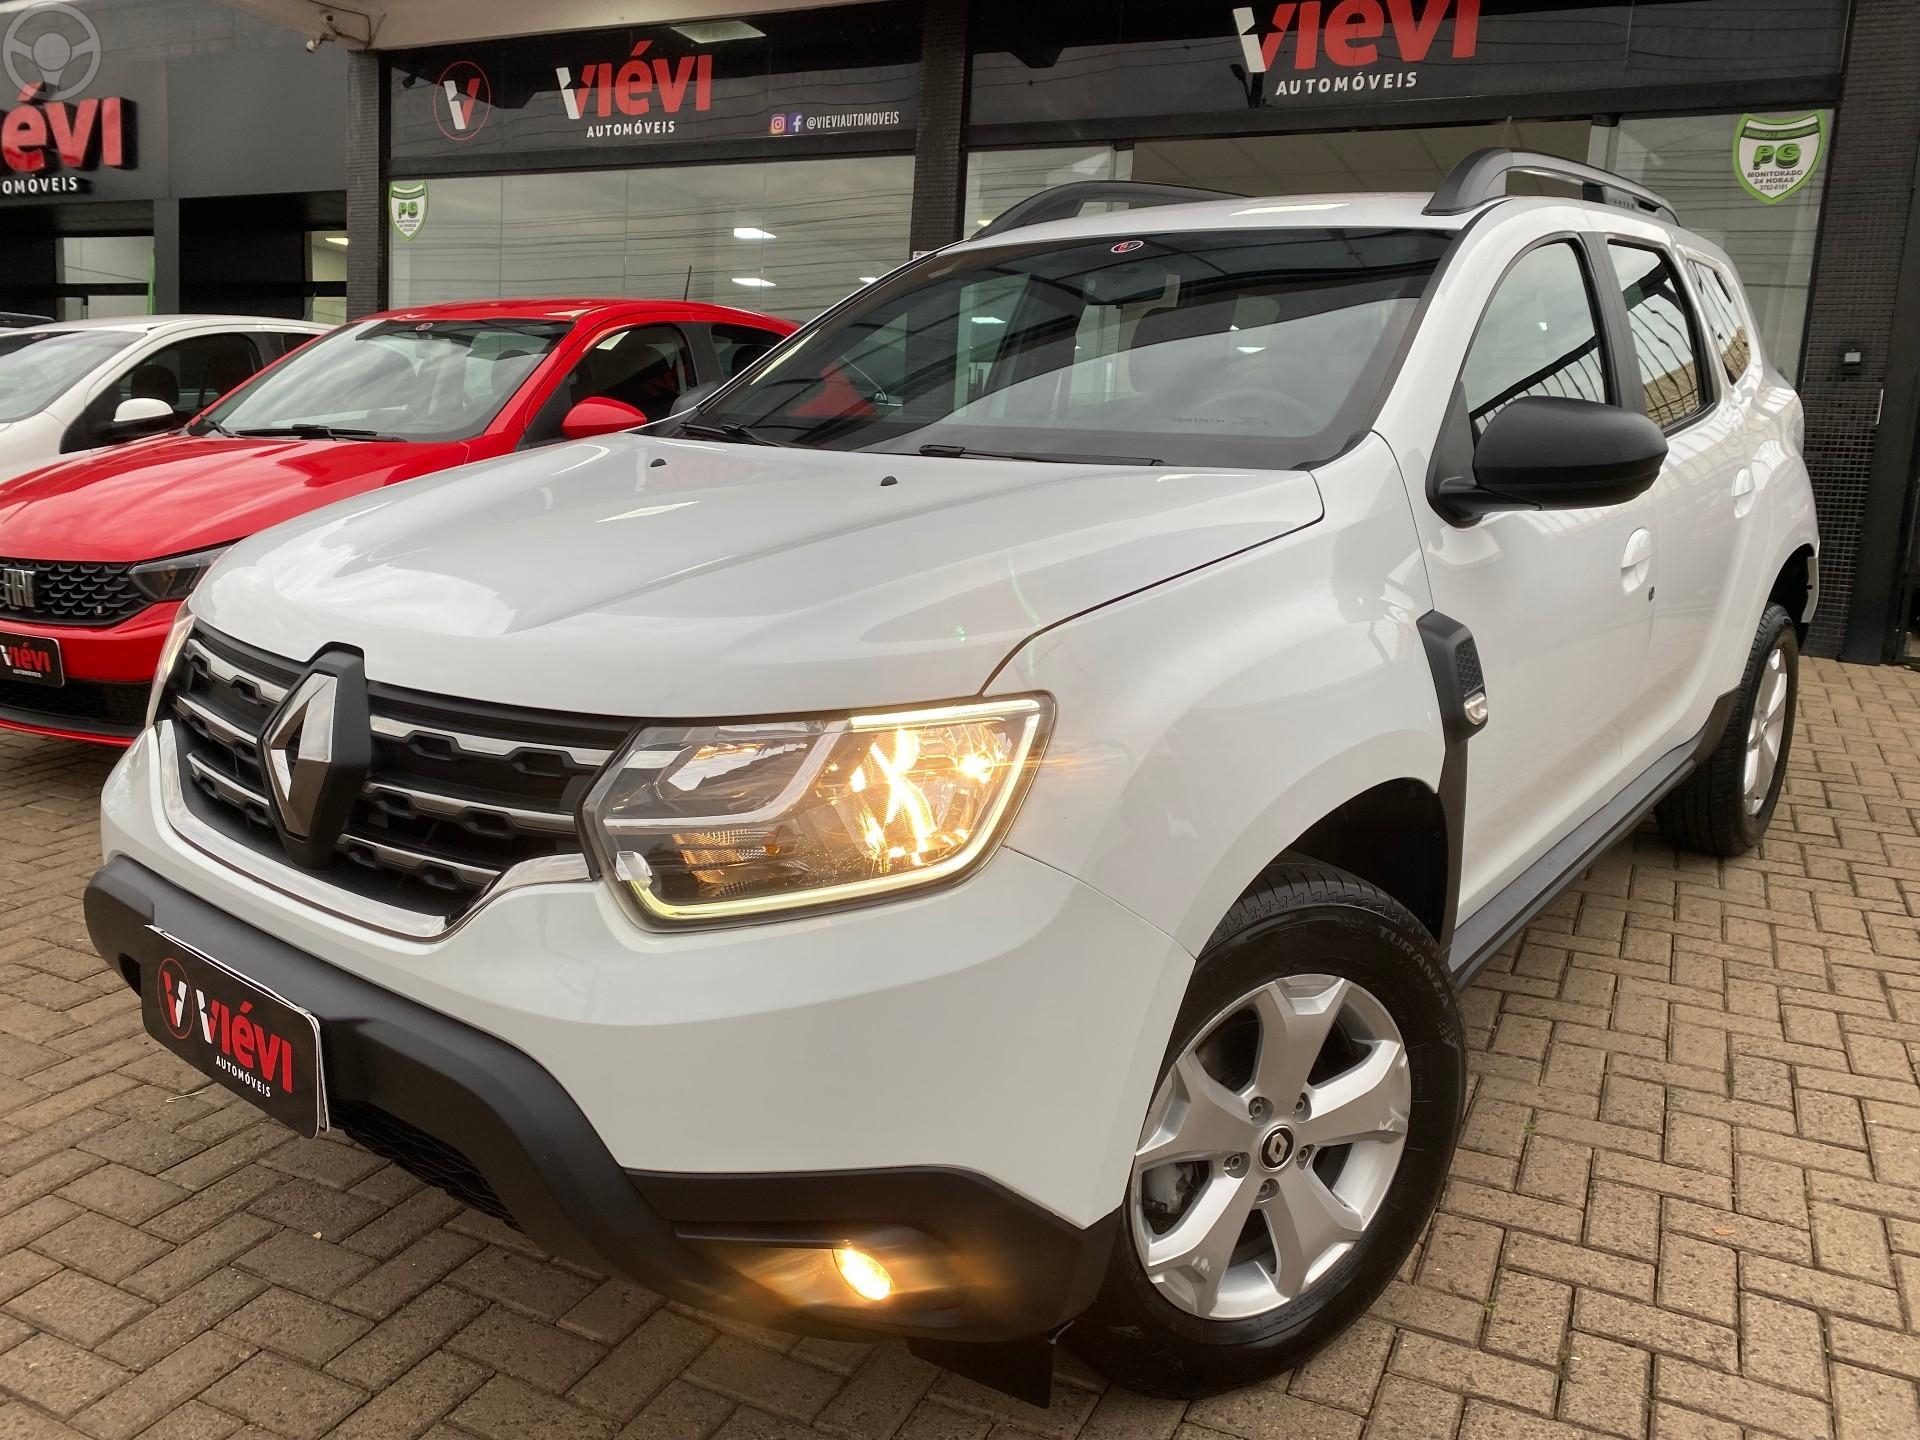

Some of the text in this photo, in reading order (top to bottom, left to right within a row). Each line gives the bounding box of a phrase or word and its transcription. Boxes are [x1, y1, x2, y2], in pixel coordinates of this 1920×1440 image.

[1276, 71, 1418, 96] AUTOMÓVEIS
[586, 120, 676, 138] AUTOMÓVEIS
[806, 111, 900, 130] @VIEVIAUTOMOVEIS
[1753, 143, 1801, 170] PG
[2, 174, 78, 194] OMÓVEIS
[1747, 170, 1803, 178] MONITORADO
[1378, 925, 1450, 1009] TURANZA
[215, 1055, 271, 1098] AUTOMÓVEIS
